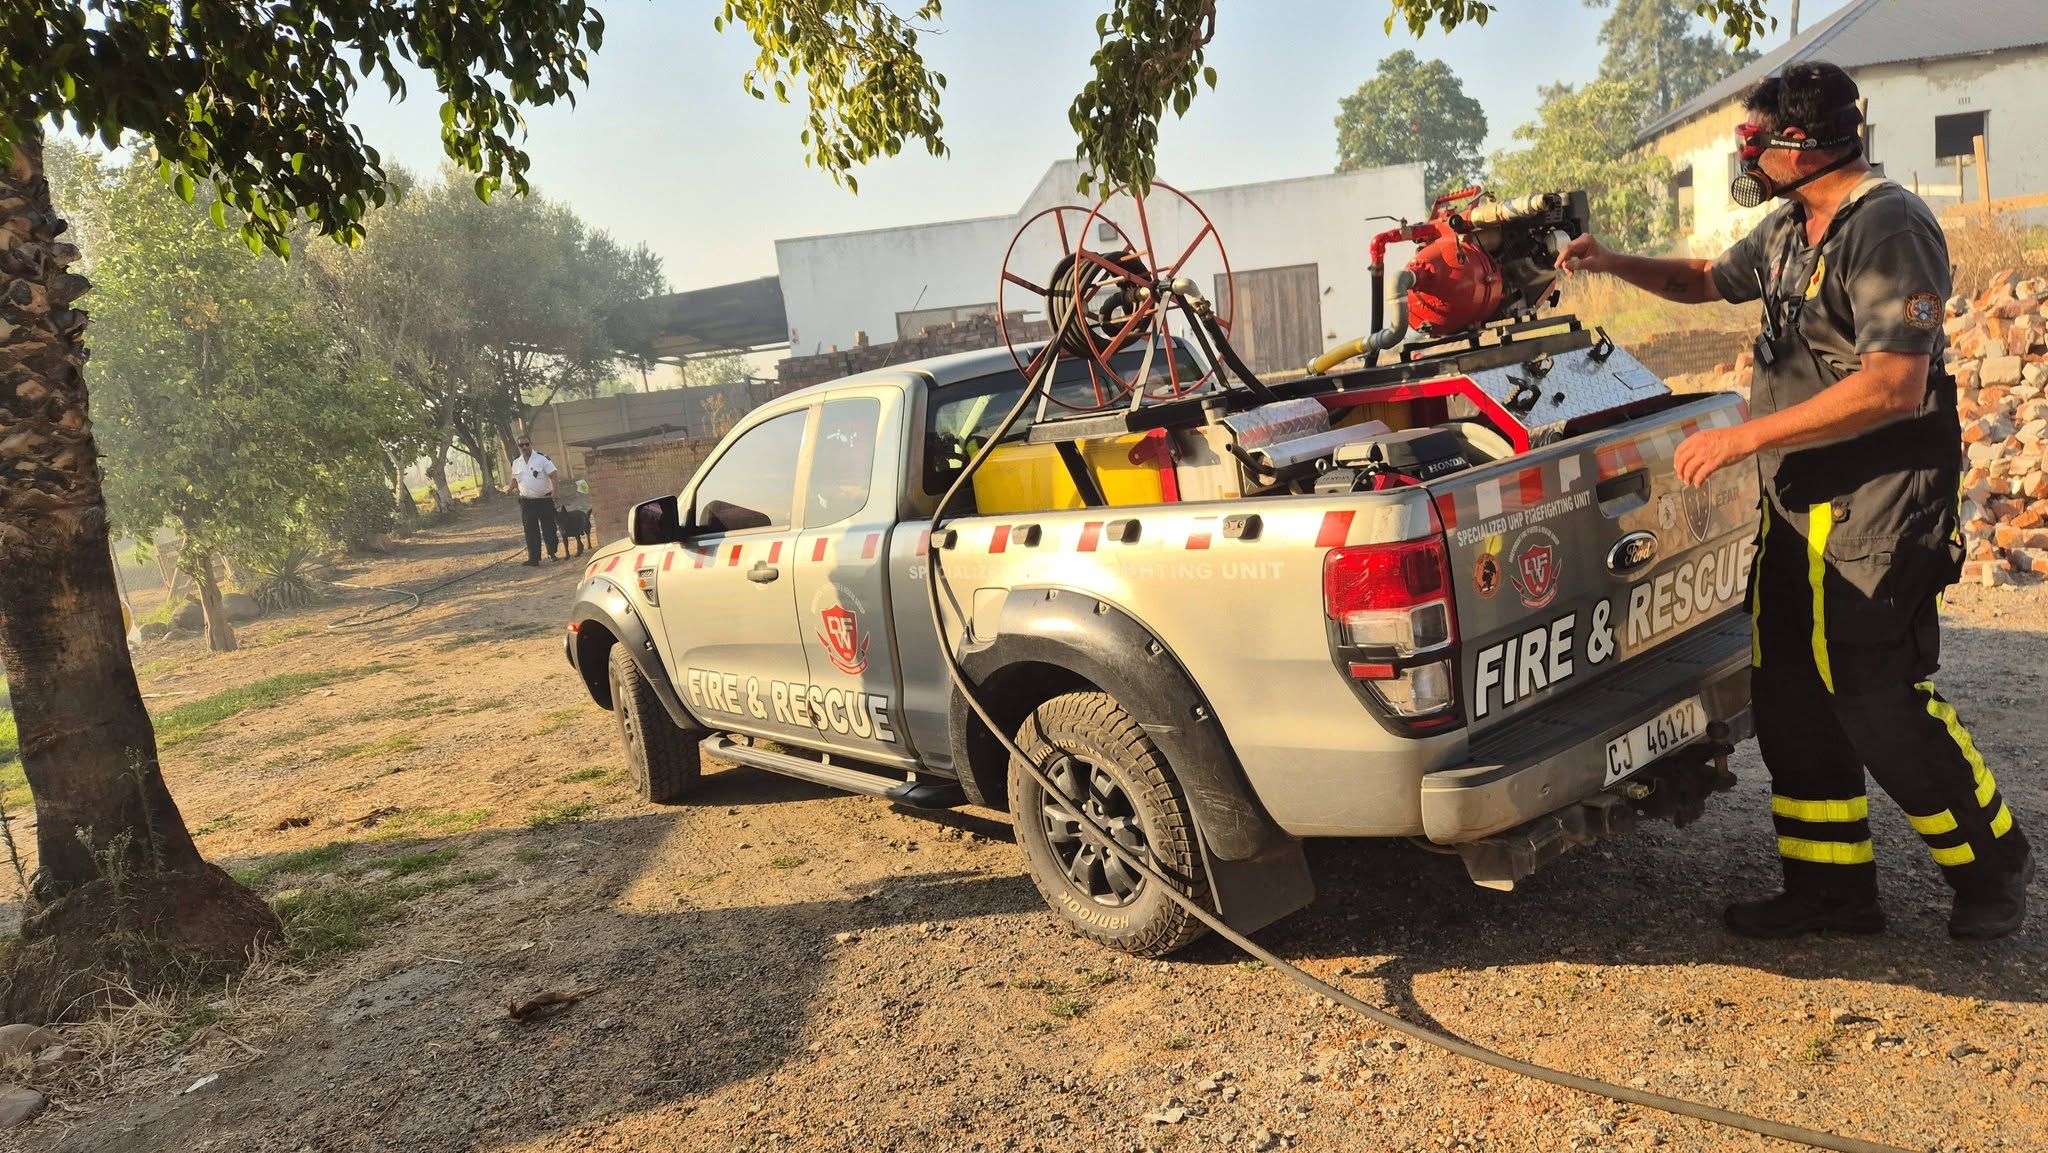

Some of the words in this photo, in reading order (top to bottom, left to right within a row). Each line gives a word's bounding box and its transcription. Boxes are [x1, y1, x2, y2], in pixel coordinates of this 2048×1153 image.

[1428, 456, 1467, 474] HONDA
[1456, 520, 1507, 547] SPECIALIZED
[1508, 513, 1524, 531] UHP
[1524, 499, 1574, 526] FIREFIGHTING
[1574, 490, 1591, 507] UNIT
[1222, 561, 1284, 580] UNIT
[1625, 541, 1651, 566] Ford
[1473, 609, 1578, 722] FIRE
[1586, 598, 1617, 665] &
[1624, 532, 1759, 650] RESCUE
[687, 667, 744, 716] FIRE
[746, 675, 769, 721] &
[770, 679, 896, 744] RESCUE
[1608, 735, 1633, 776] CJ
[1646, 702, 1695, 755] 46127
